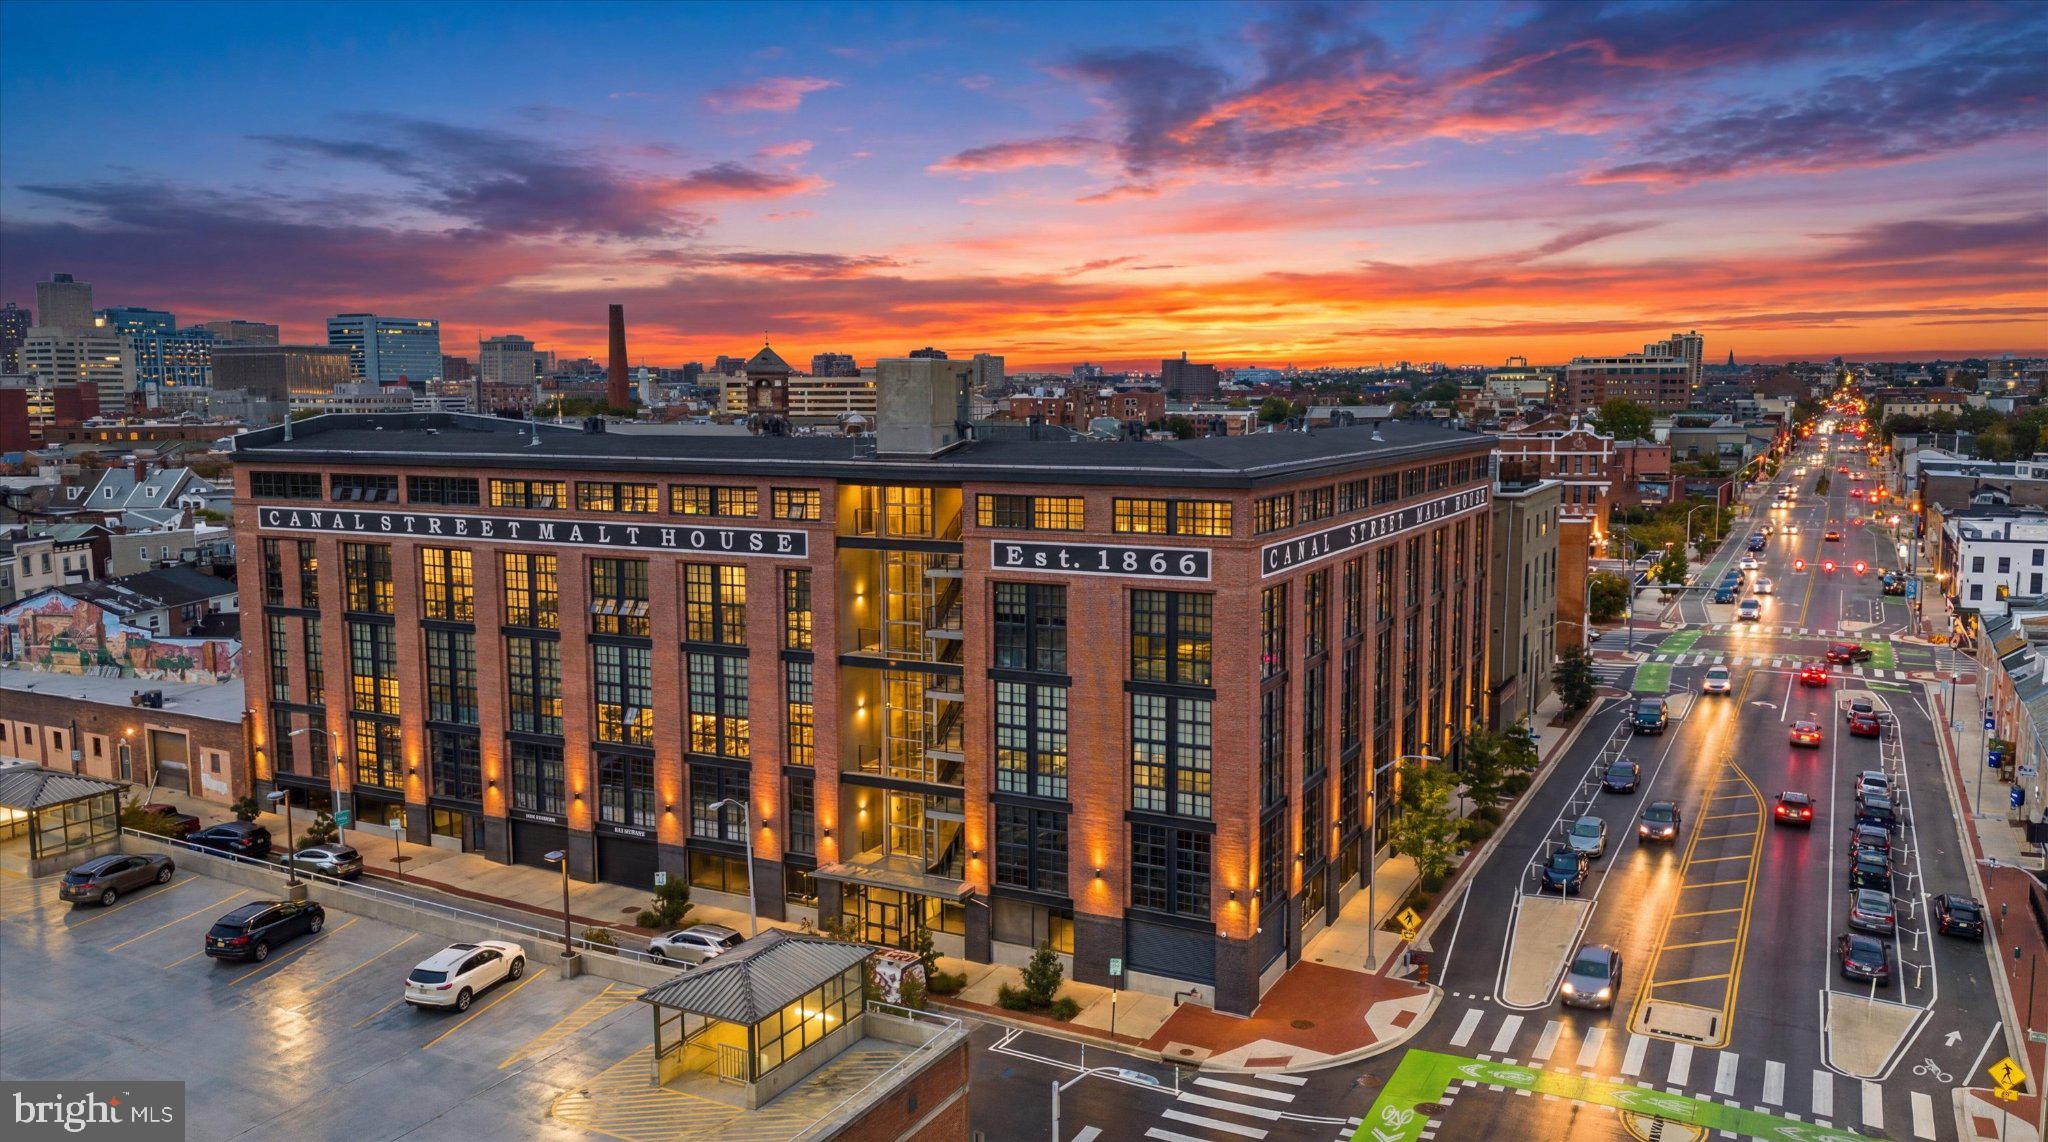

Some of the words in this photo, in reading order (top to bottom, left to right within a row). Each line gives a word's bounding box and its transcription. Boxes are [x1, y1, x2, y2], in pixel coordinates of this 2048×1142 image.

[269, 509, 366, 531] CANAL
[380, 515, 521, 539] STREET
[538, 523, 640, 545] MALT
[660, 528, 794, 553] HOUSE
[1269, 533, 1330, 569] CANAL
[1350, 512, 1404, 544] STREET
[1416, 500, 1446, 524] MALT
[1455, 489, 1486, 512] HOUSE
[1005, 545, 1081, 569] Est.
[1098, 549, 1197, 575] 1866
